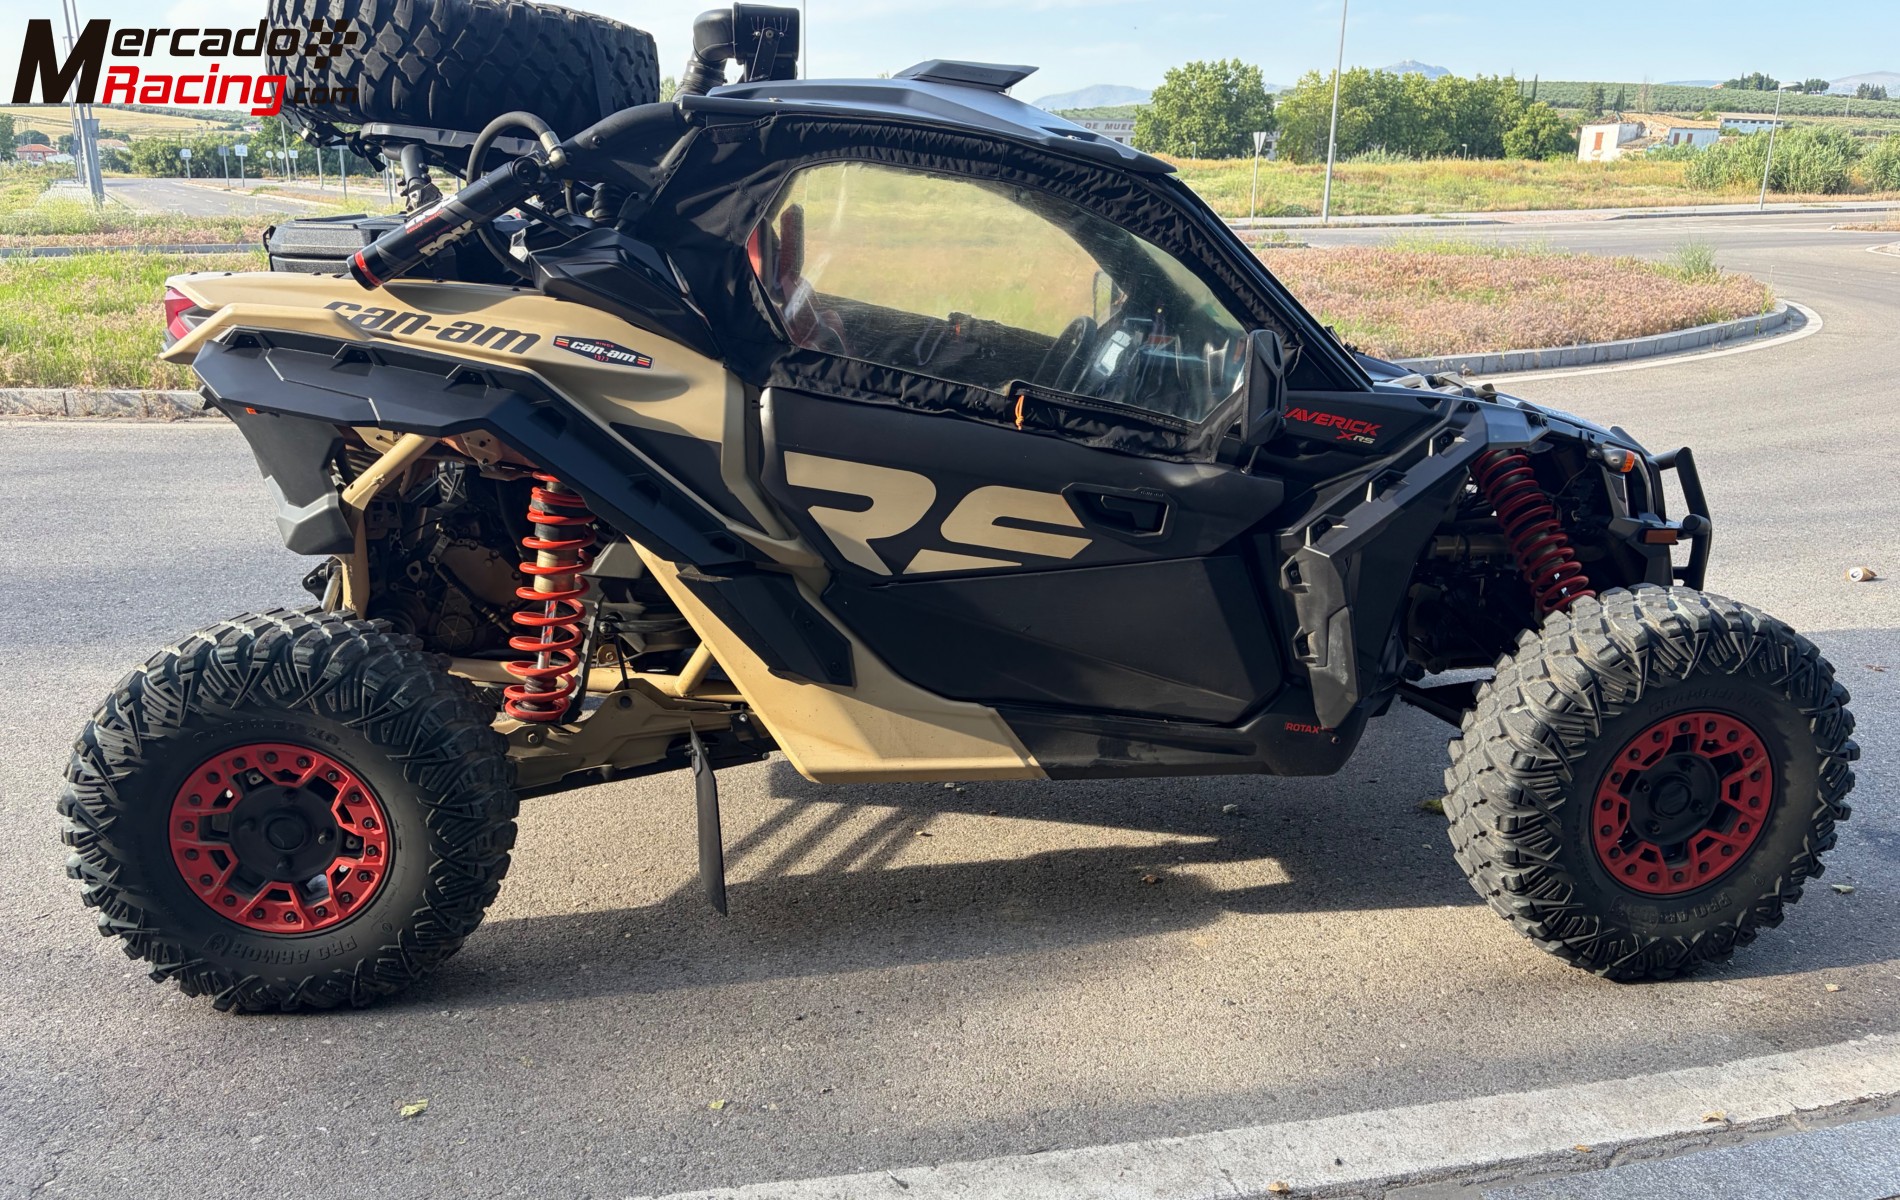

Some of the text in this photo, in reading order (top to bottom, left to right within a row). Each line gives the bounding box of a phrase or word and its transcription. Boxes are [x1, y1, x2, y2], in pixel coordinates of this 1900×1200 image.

[1085, 122, 1099, 130] DE
[570, 341, 636, 363] can-am
[1285, 405, 1382, 436] AVERICK
[784, 451, 1093, 576] RS
[1284, 722, 1319, 734] ROTAX
[230, 936, 358, 965] PRO ARMOR
